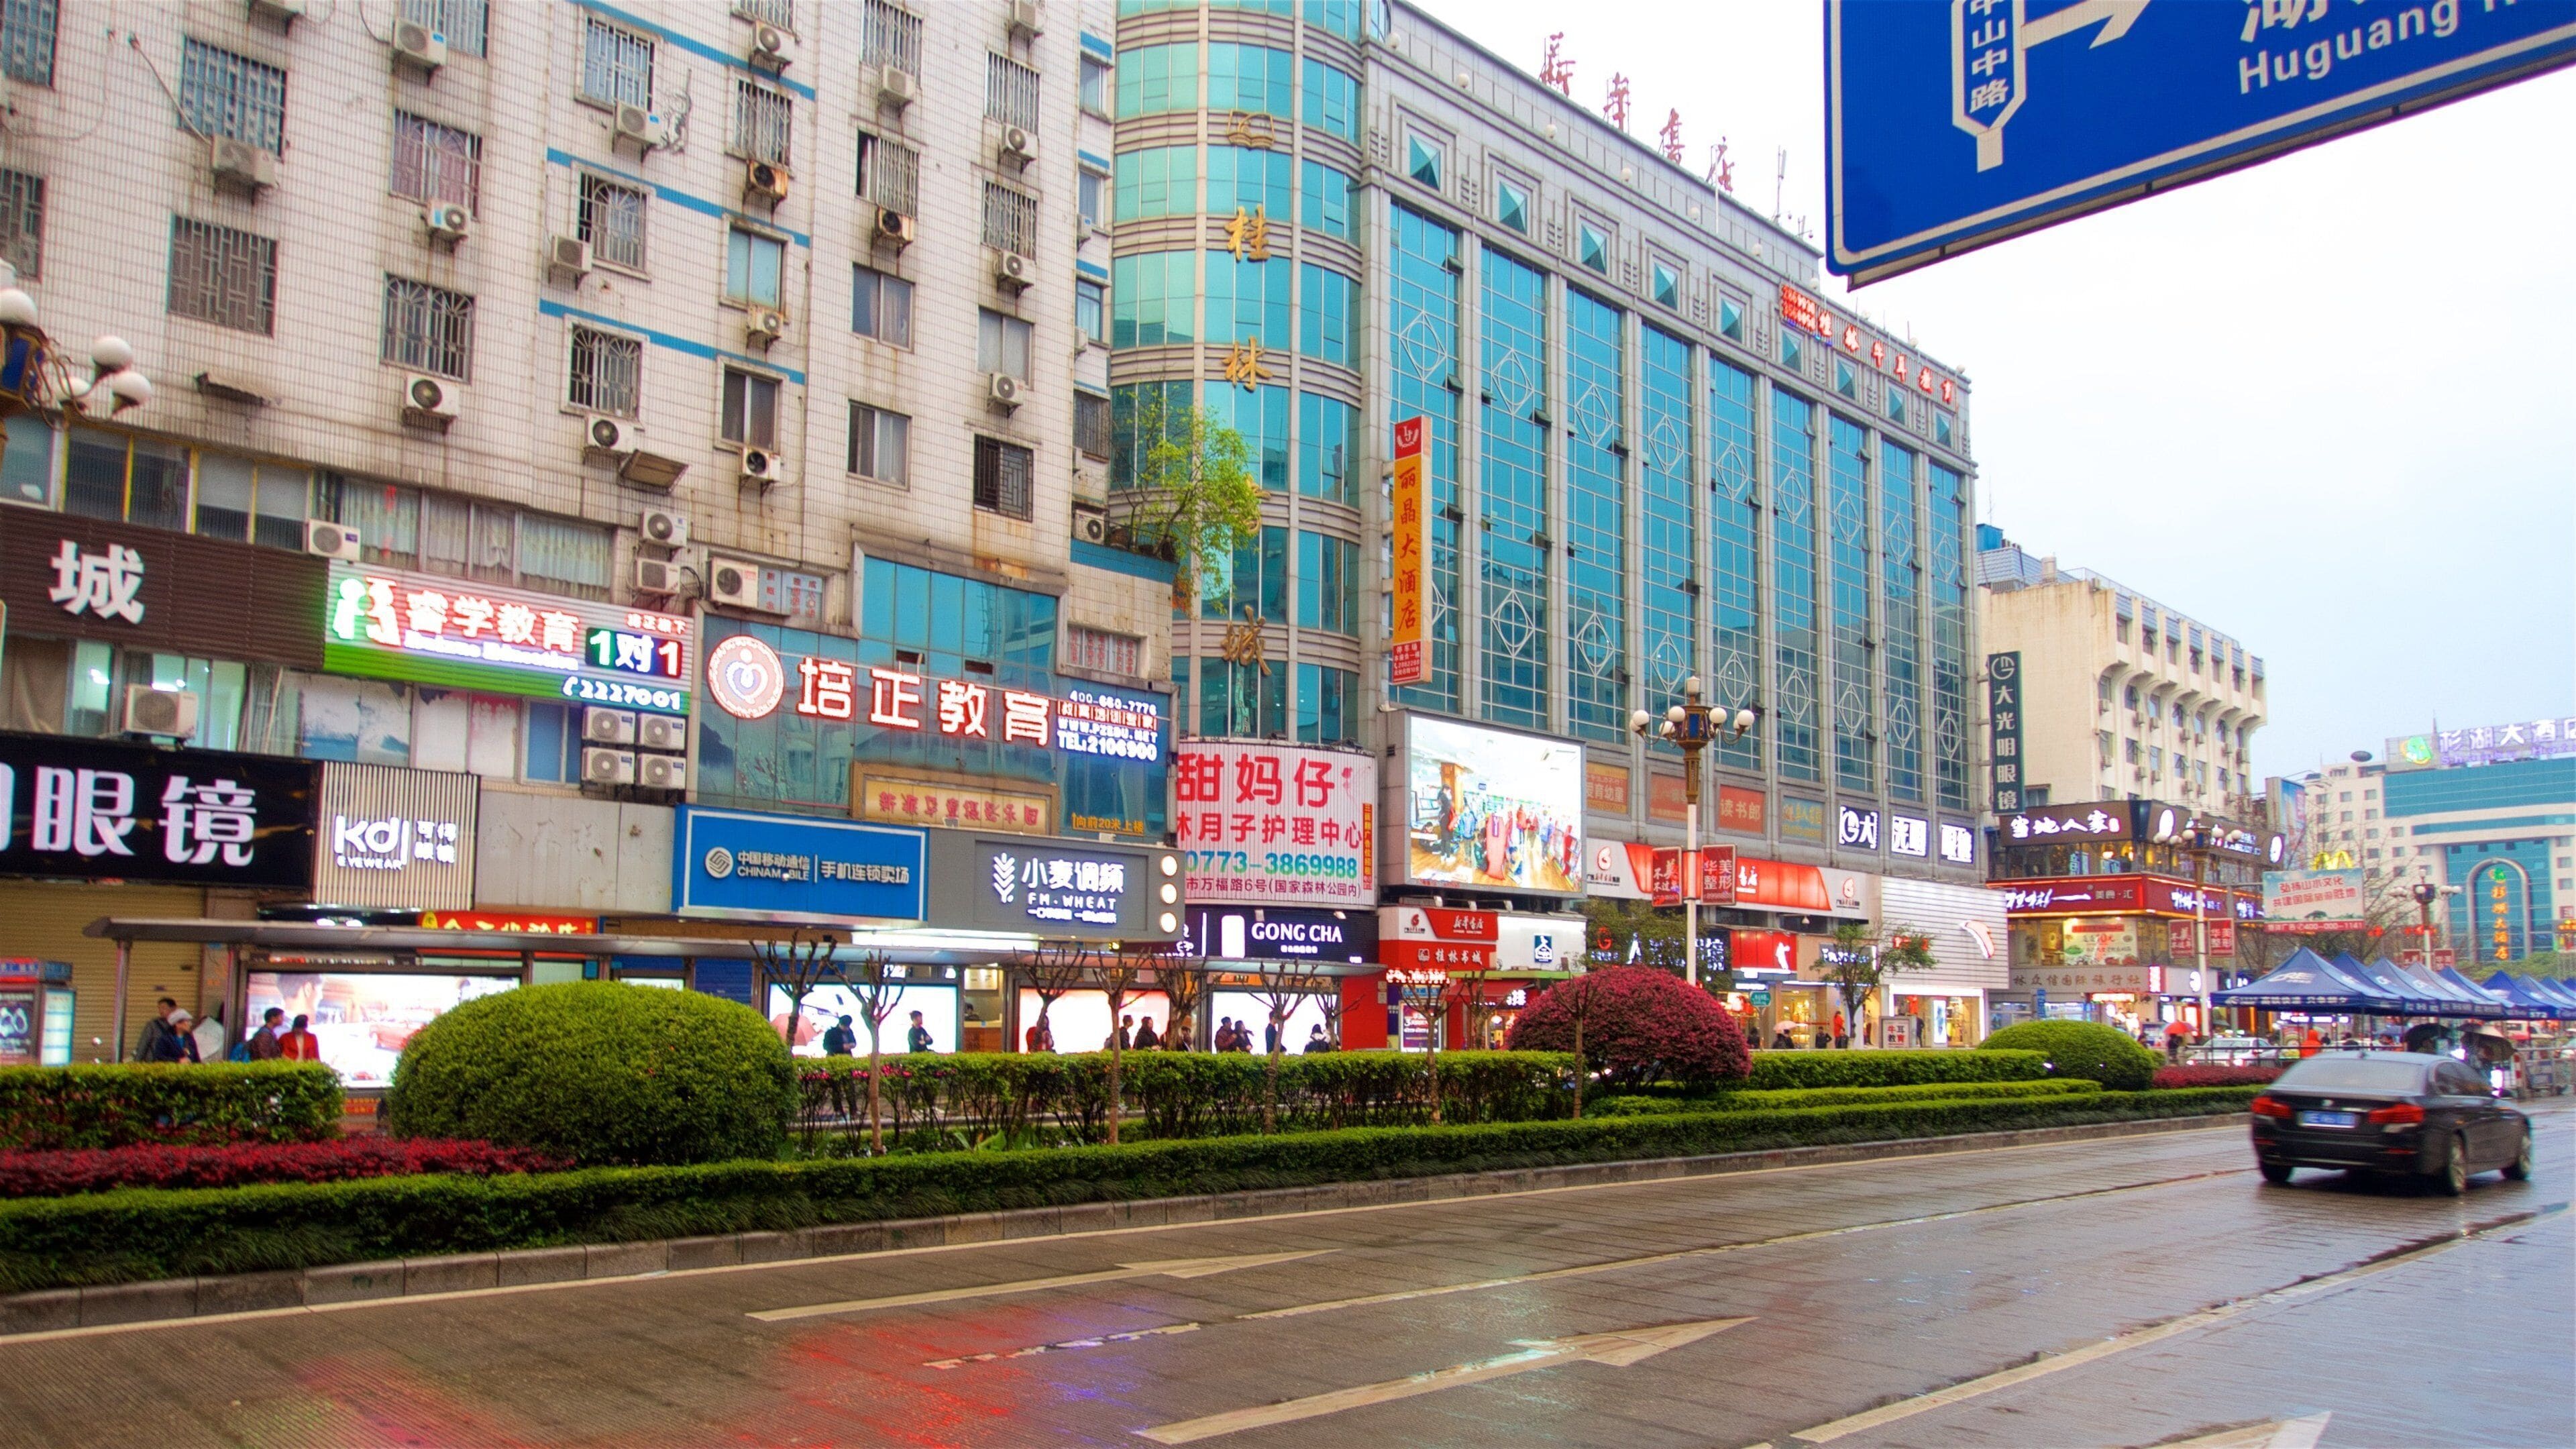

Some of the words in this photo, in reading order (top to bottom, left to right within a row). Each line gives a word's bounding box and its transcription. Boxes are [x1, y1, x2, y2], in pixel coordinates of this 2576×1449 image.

[2238, 0, 2460, 95] Huguang
[1397, 466, 1417, 633] 丽晶大酒店
[49, 539, 145, 625] 城
[589, 629, 679, 676] 1对1
[578, 680, 680, 711] 2227001
[797, 656, 1050, 746] 培正教育
[1995, 686, 2017, 810] 大光明眼镜
[1177, 753, 1335, 808] 甜妈仔
[0, 762, 257, 866] 眼镜
[1721, 799, 1760, 820] 读书郎
[2011, 810, 2108, 839] 当地人家
[738, 851, 810, 870] 中国移动通信
[821, 861, 909, 884] 手机连锁卖场
[1021, 858, 1124, 893] 小麦调频
[1185, 851, 1357, 879] 0773-3869988
[1703, 859, 1733, 875] 华美
[1703, 875, 1733, 890] 整形
[1252, 922, 1305, 941] GONG
[1309, 924, 1342, 943] CHA
